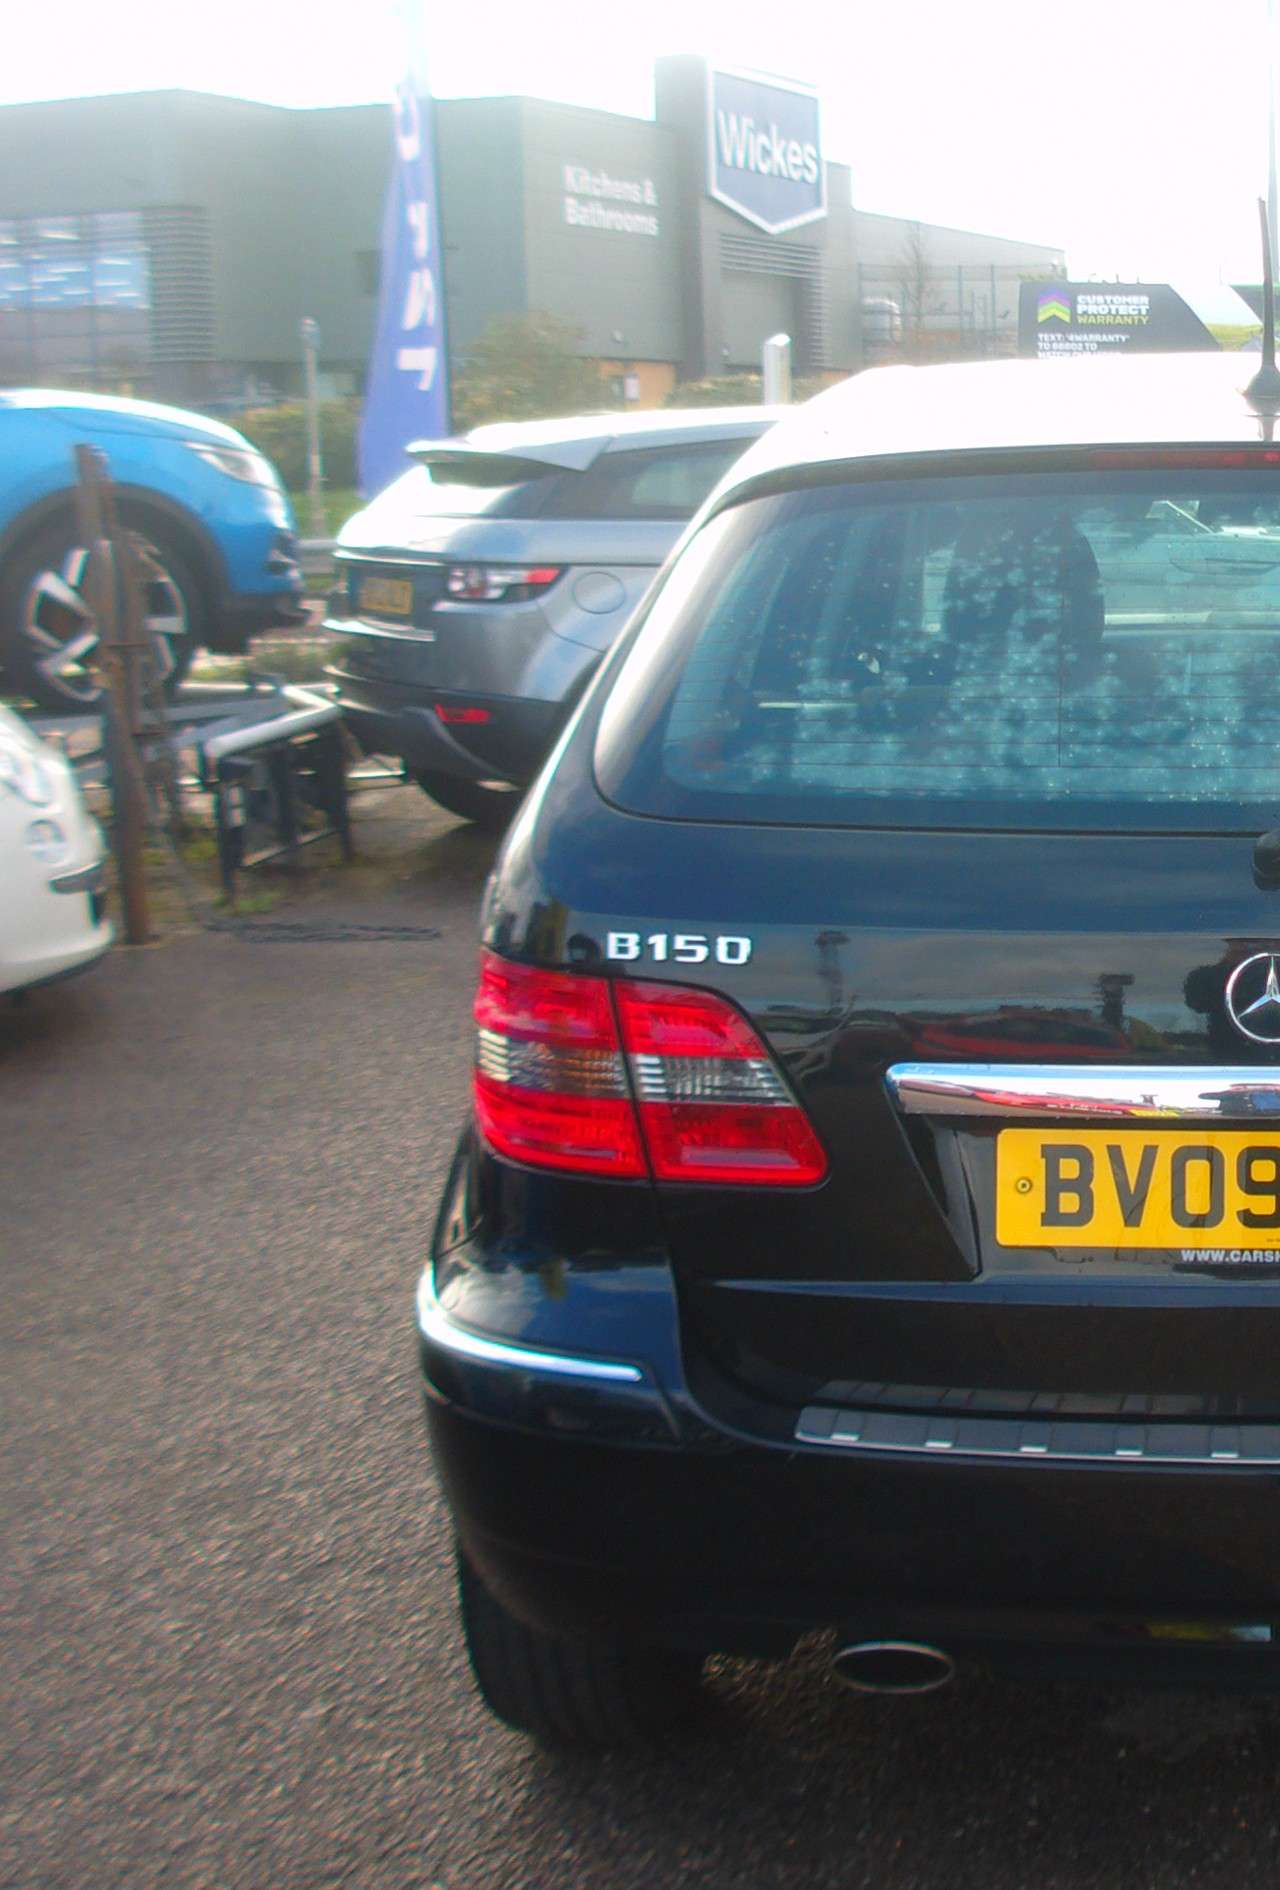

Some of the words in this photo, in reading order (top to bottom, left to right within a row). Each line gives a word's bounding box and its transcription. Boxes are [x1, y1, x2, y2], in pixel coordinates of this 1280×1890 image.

[716, 109, 818, 184] Wickes
[563, 164, 642, 202] Kitchens
[564, 196, 658, 236] Bathrooms
[1076, 294, 1150, 305] CUSTOMER
[1076, 304, 1150, 315] PROTECT
[1076, 315, 1150, 325] WARRANTY
[606, 932, 752, 964] B150
